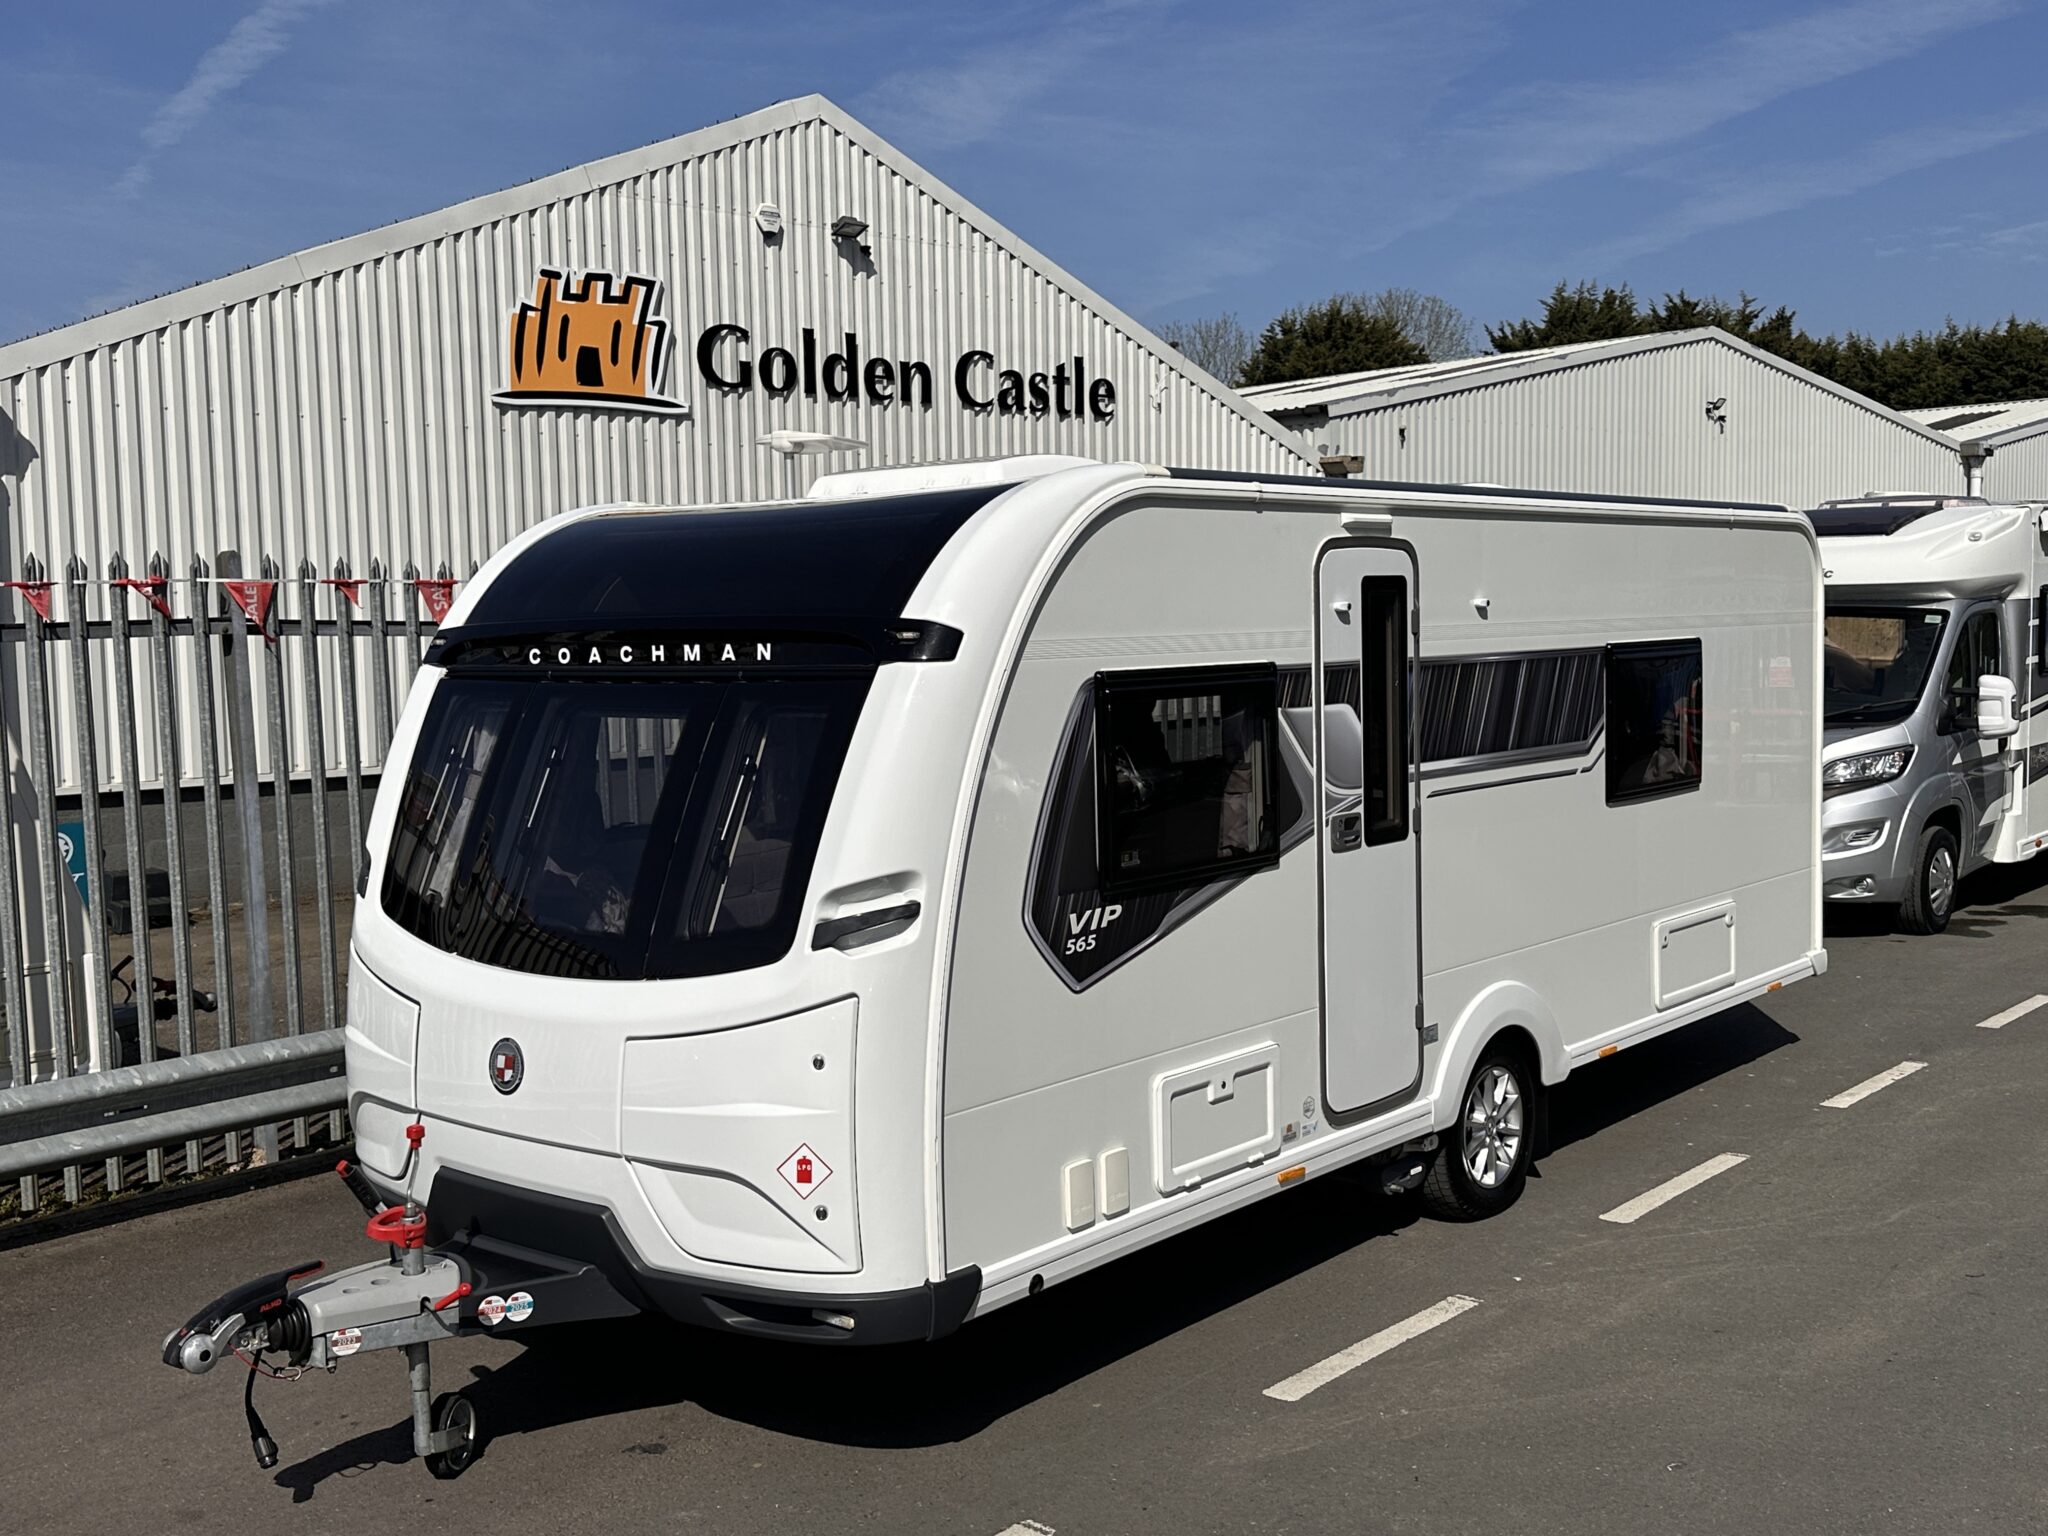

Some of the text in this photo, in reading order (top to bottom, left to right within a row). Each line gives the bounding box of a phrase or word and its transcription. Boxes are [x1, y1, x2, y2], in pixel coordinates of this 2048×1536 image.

[697, 324, 1115, 417] Golden Castle
[529, 643, 772, 665] COACHMAN
[1069, 904, 1123, 935] VIP
[1065, 934, 1097, 955] 565
[797, 1164, 812, 1172] LPG
